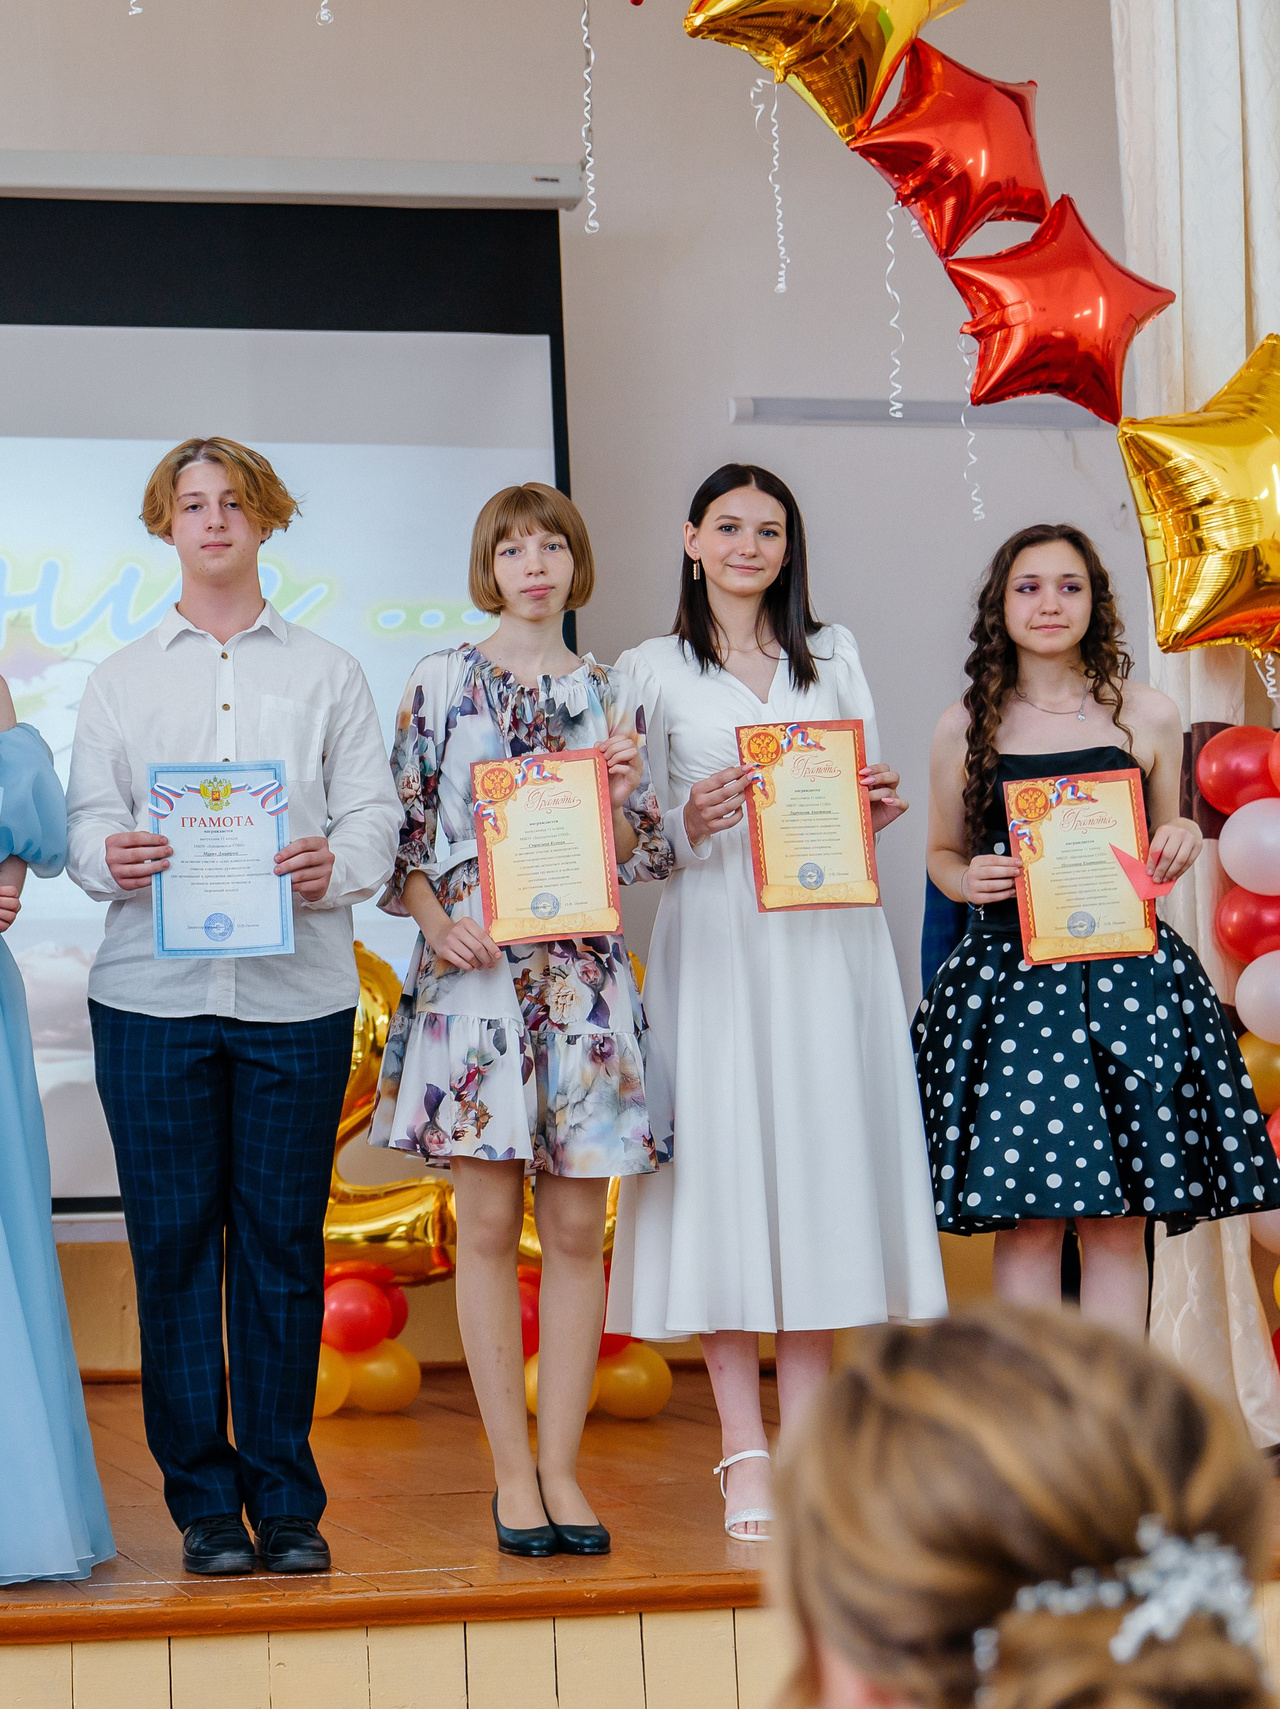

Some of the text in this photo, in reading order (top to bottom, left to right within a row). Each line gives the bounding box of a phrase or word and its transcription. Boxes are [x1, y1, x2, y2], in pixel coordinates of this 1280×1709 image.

[790, 753, 842, 782] Грамота
[524, 786, 582, 814] Грамота
[181, 815, 254, 828] ГРАМОТА
[1060, 806, 1117, 834] Грамота
